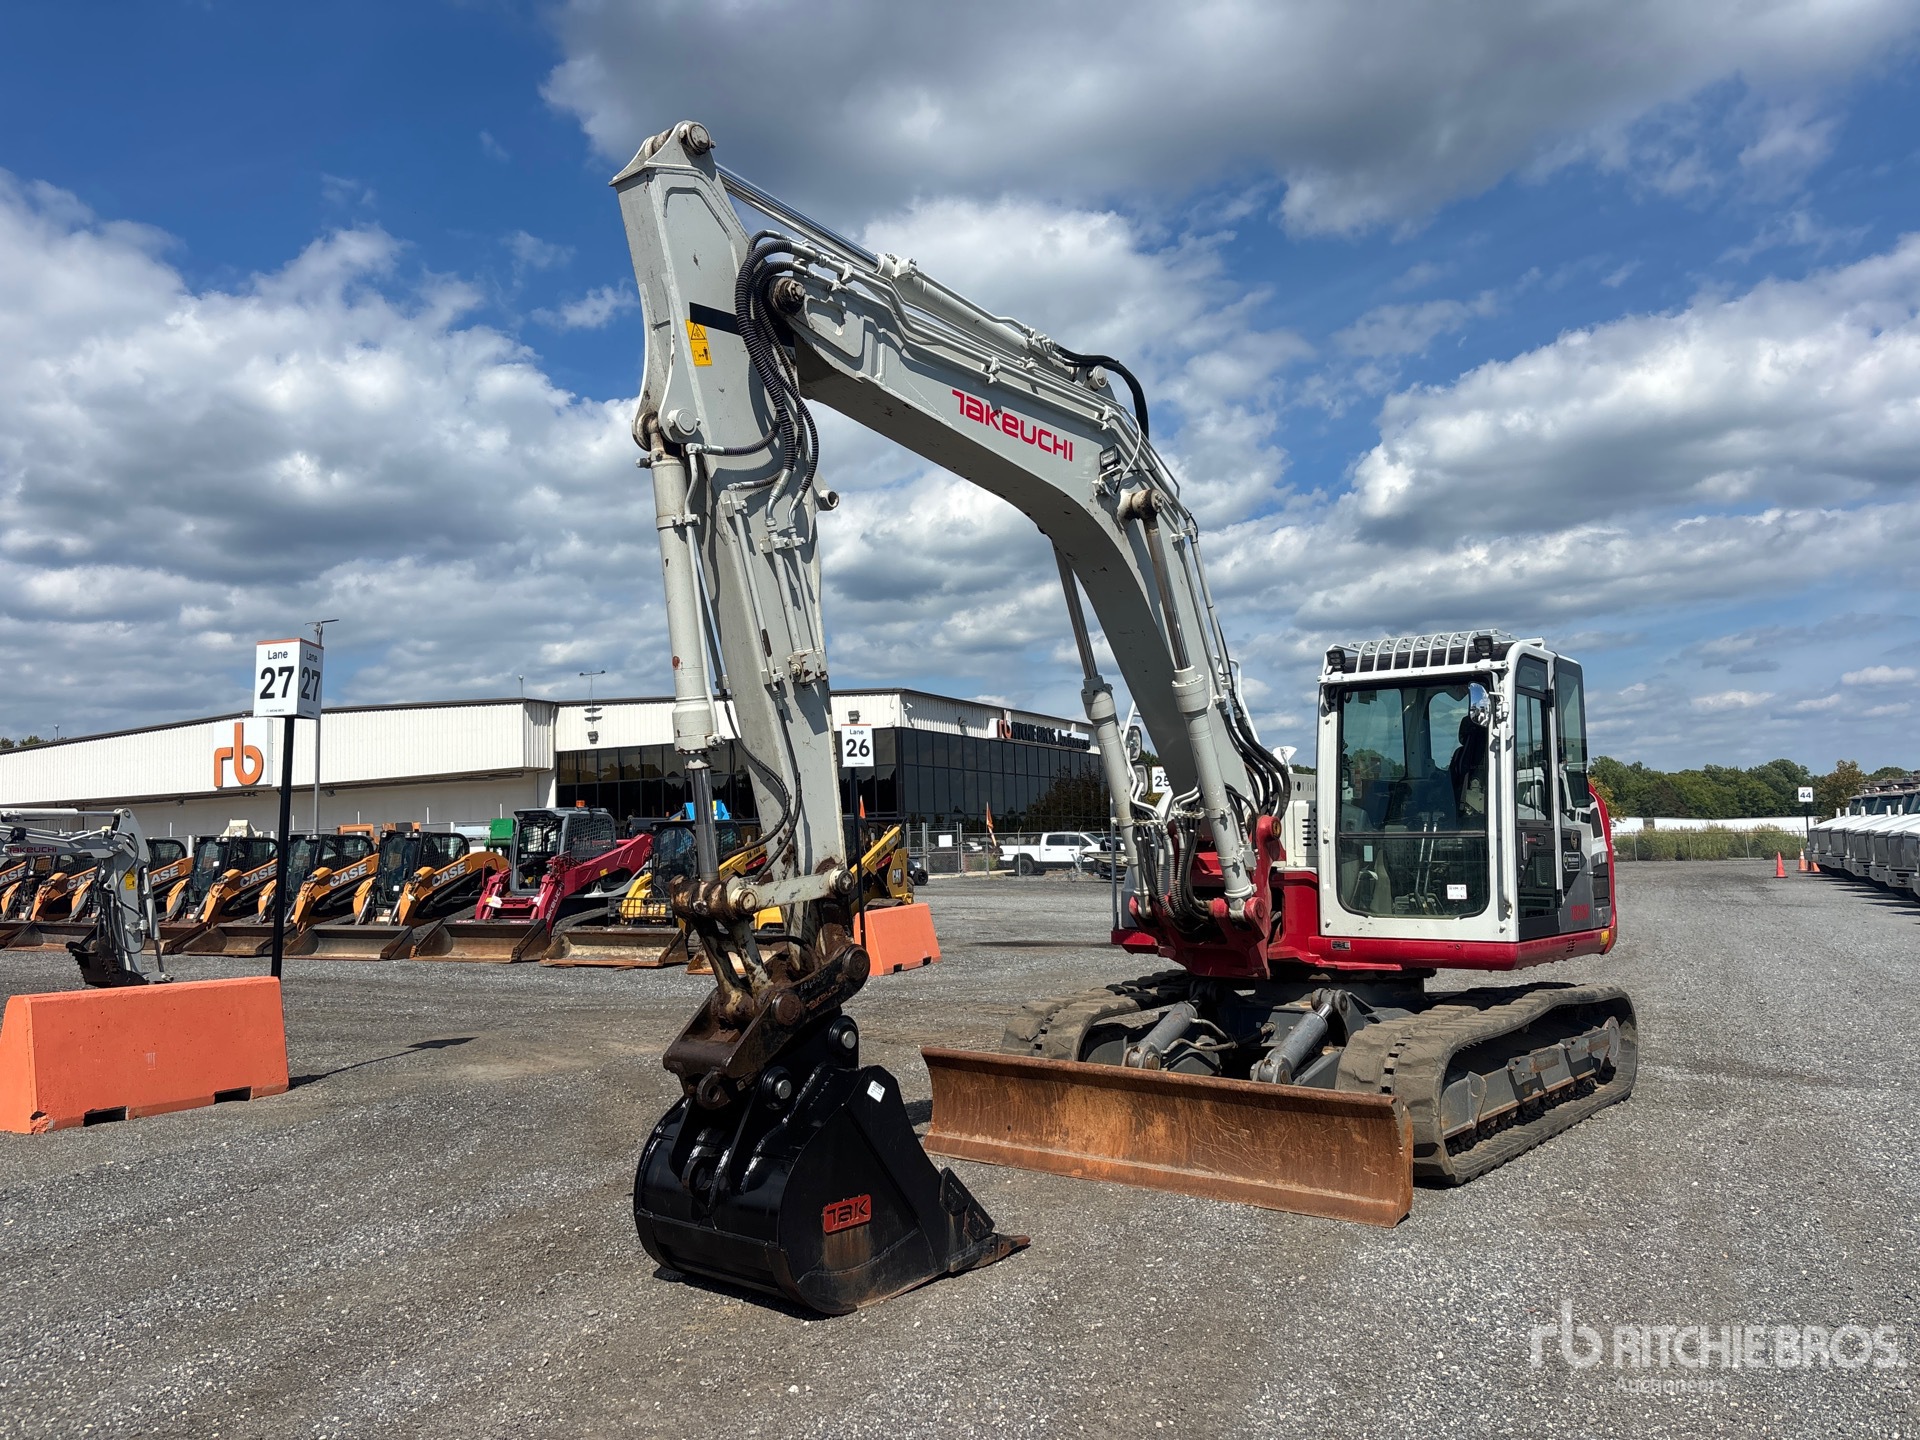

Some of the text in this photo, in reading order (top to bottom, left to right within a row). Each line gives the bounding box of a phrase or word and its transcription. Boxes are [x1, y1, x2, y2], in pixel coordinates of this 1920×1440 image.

[268, 650, 288, 660] Lane
[306, 650, 318, 662] Lane
[260, 666, 294, 699] 27
[301, 667, 320, 701] 27
[214, 722, 264, 787] rb
[846, 738, 870, 757] 26
[1155, 776, 1170, 787] 25
[0, 866, 26, 884] ASE
[66, 872, 95, 889] CAS
[151, 865, 179, 885] ASE
[240, 864, 278, 887] CASE
[329, 863, 367, 887] CASE
[432, 863, 466, 887] CASE
[826, 1199, 869, 1225] TAK
